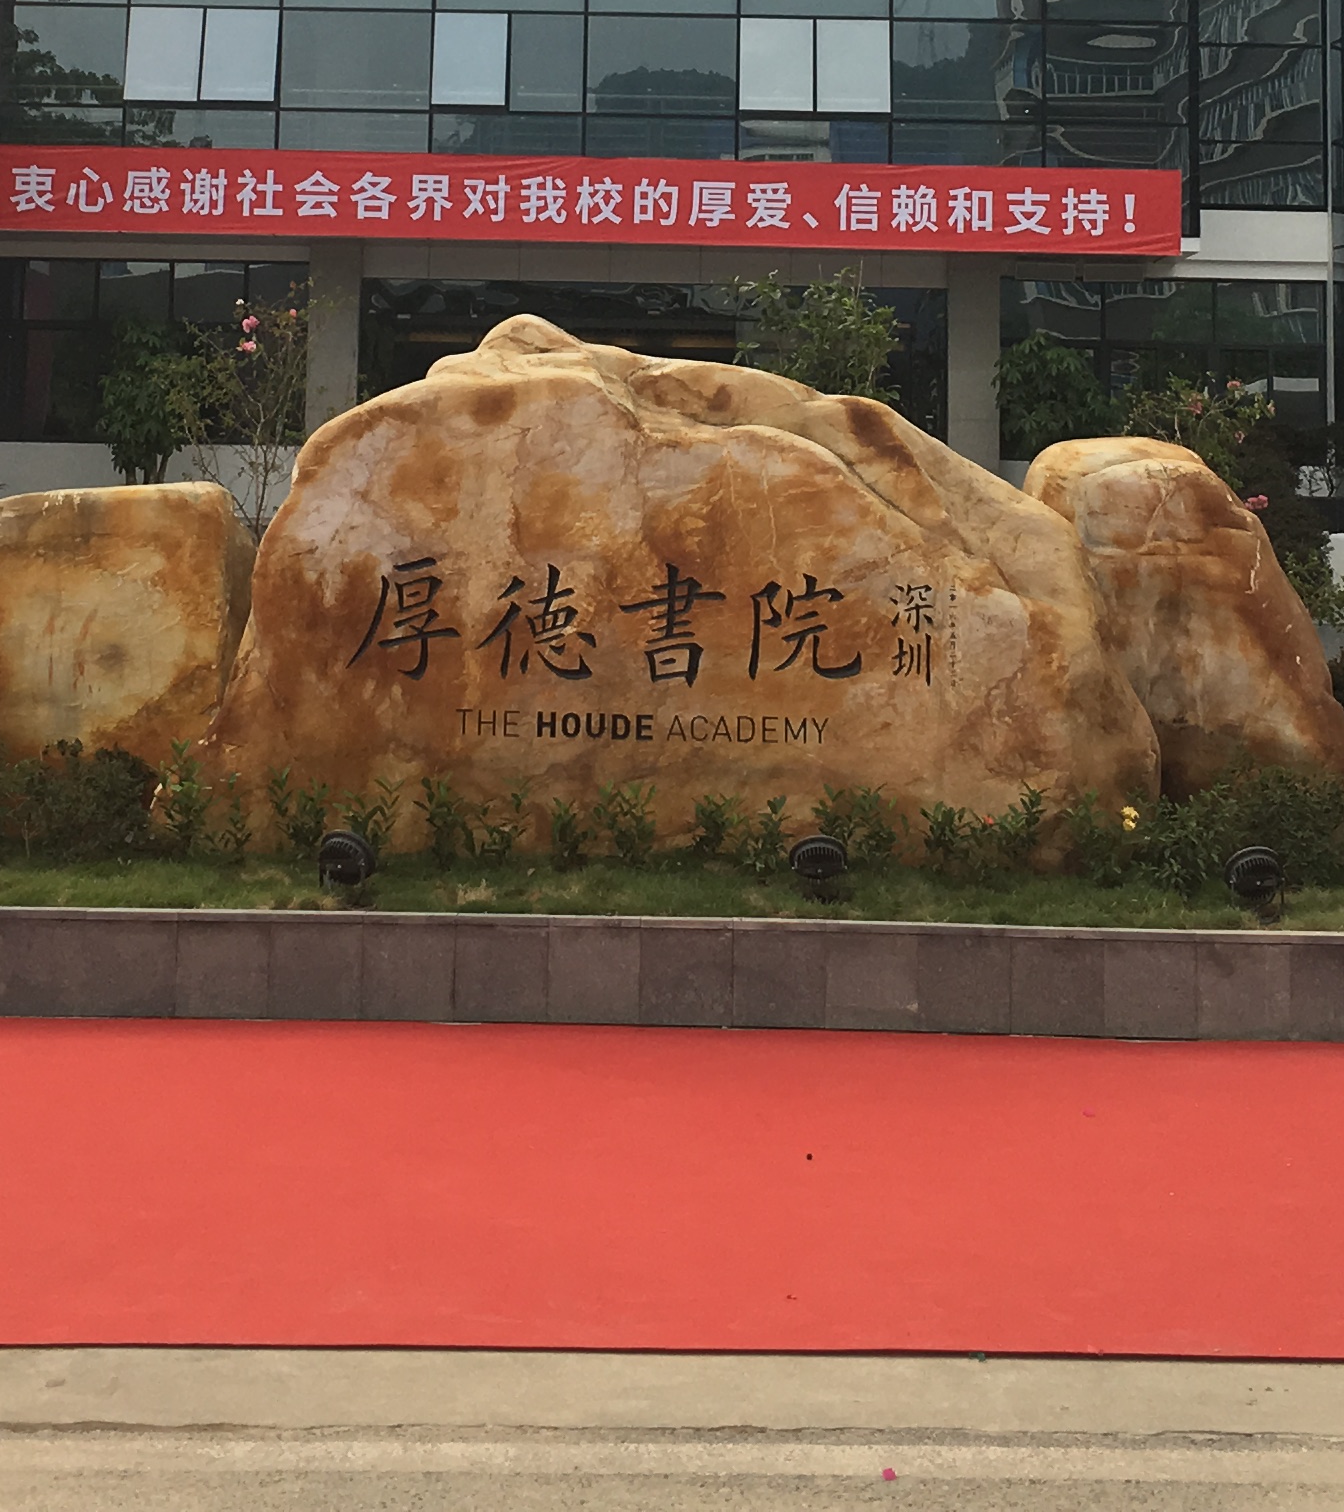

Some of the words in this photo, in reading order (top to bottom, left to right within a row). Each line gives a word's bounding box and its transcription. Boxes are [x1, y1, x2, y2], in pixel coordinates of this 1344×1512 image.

[9, 164, 1136, 237] 衷心感谢社会各界对我校的厚爱、信赖和支持！
[344, 556, 863, 689] 厚德書院
[889, 583, 934, 688] 深圳
[456, 707, 521, 739] THE
[536, 710, 655, 742] HOUDE
[665, 713, 831, 746] ACADEMY
